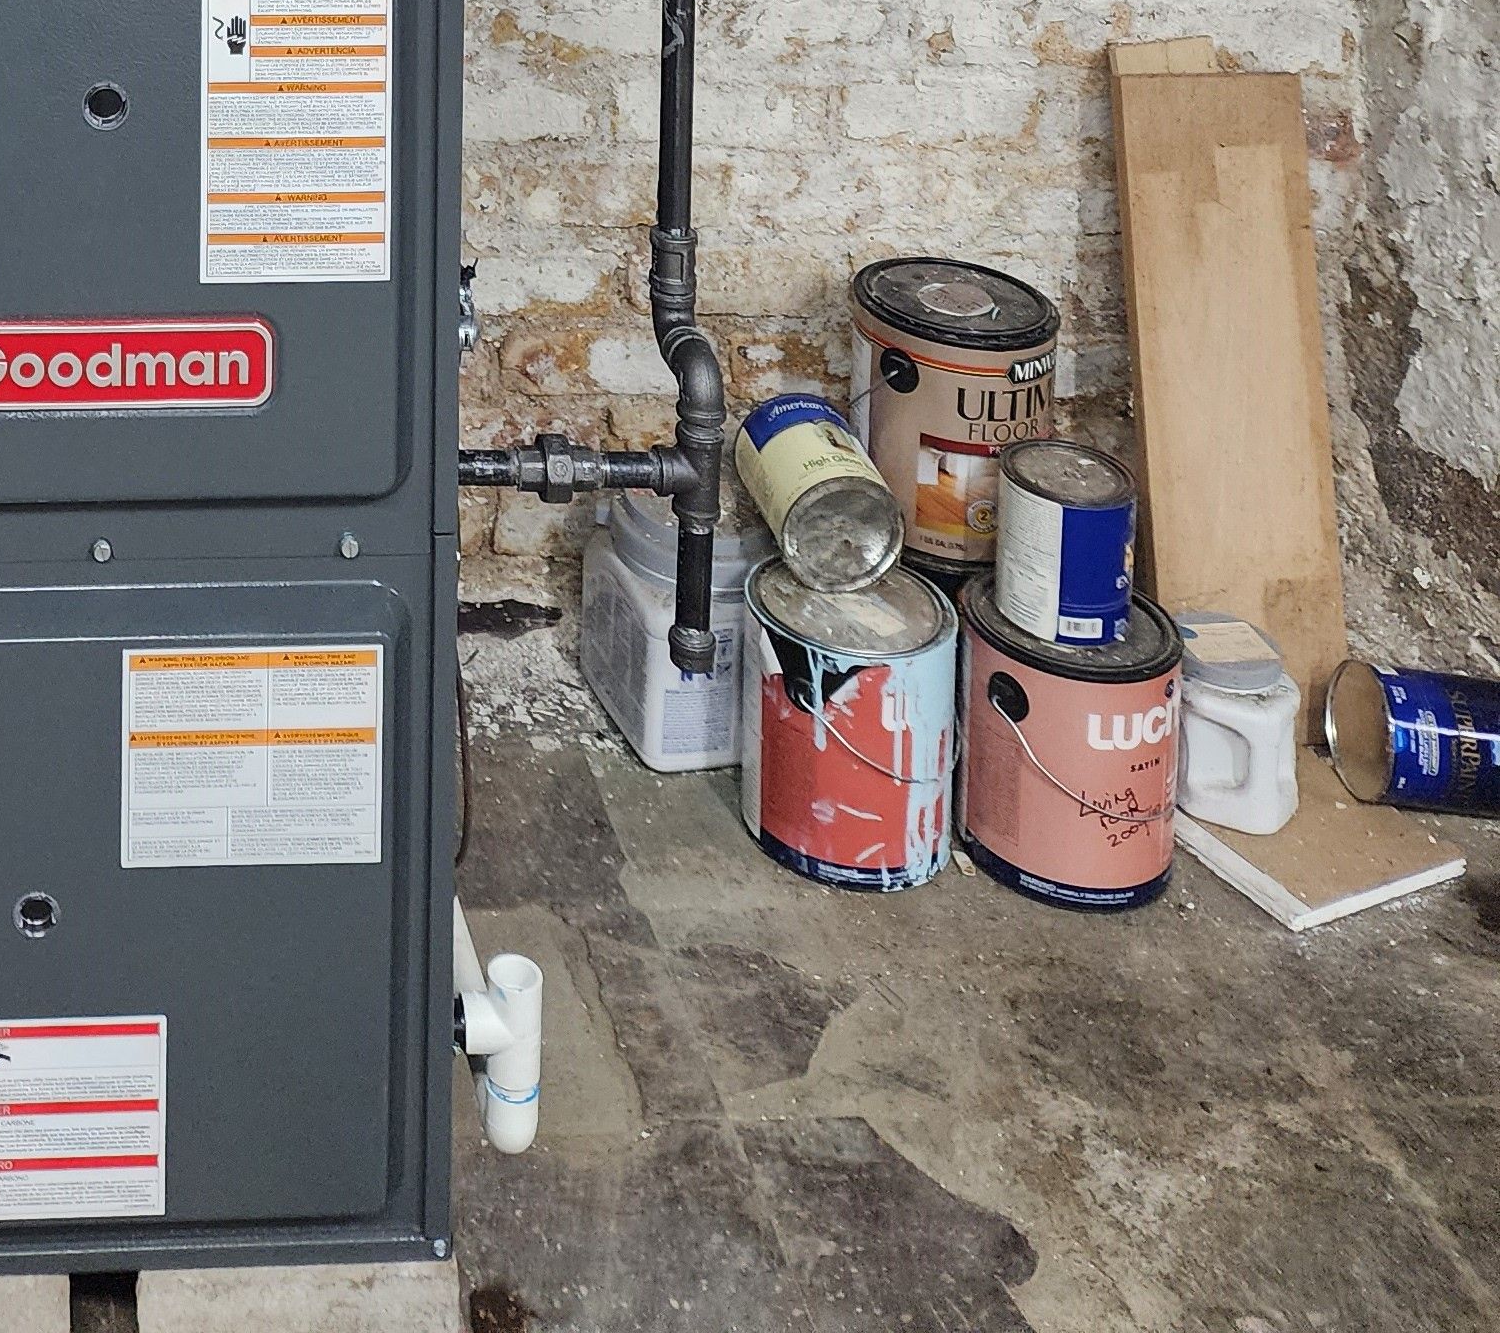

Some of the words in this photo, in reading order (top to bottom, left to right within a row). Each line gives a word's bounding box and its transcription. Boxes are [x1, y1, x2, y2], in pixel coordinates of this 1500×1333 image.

[291, 16, 361, 24] AVERTISSEMENT
[297, 47, 356, 55] ADVERTENCIA
[274, 139, 344, 147] AVERTISSEMENT
[287, 193, 328, 201] WARNING
[968, 418, 1040, 442] FLOOR
[1130, 757, 1161, 773] SATIN
